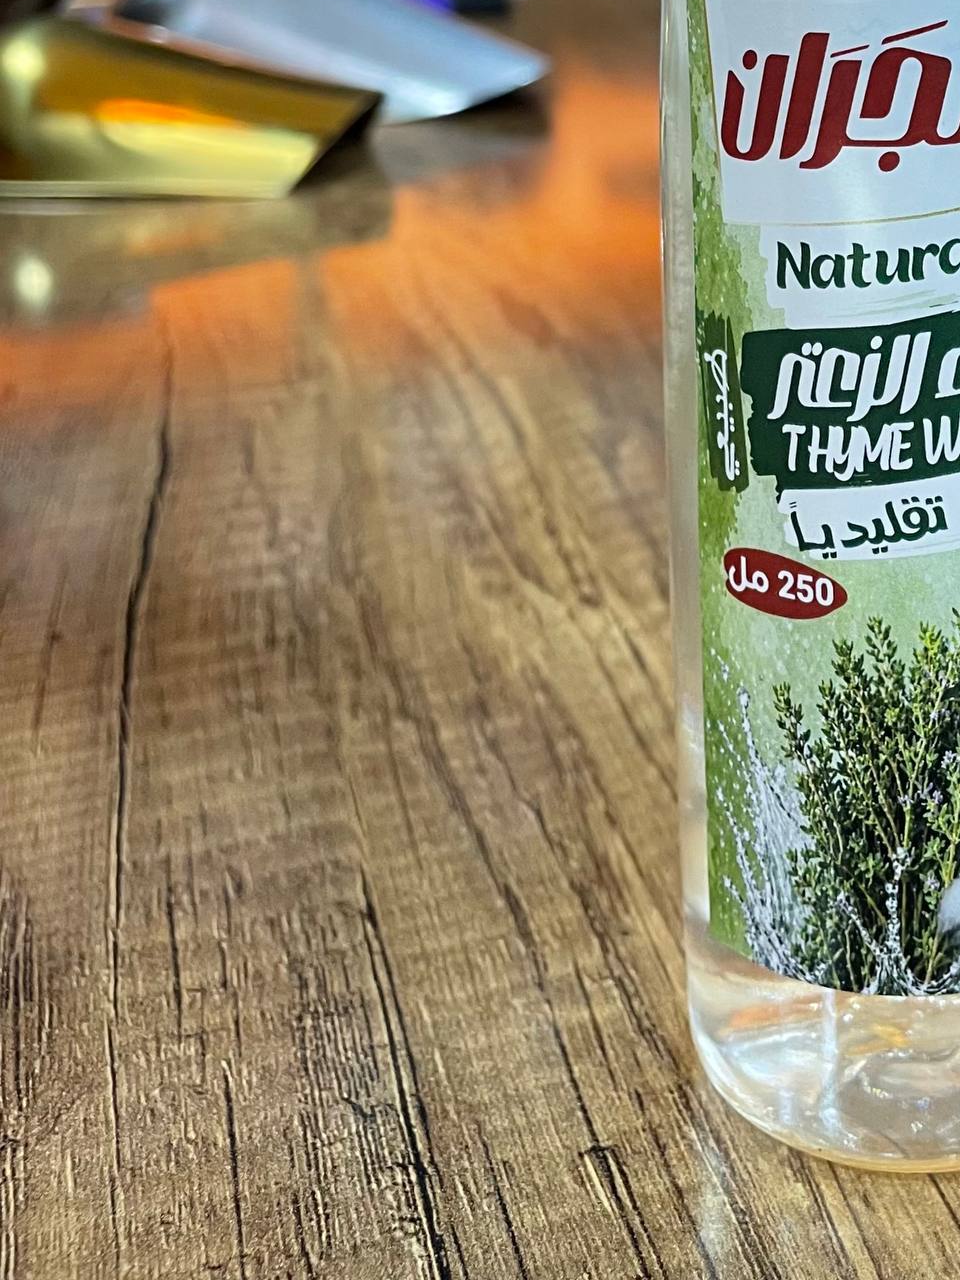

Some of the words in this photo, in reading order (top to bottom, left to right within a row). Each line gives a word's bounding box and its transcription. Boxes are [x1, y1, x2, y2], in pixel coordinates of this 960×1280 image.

[767, 331, 932, 422] الزعتر
[704, 349, 740, 481] طبيعي
[729, 555, 769, 592] مل
[777, 570, 834, 607] 250
